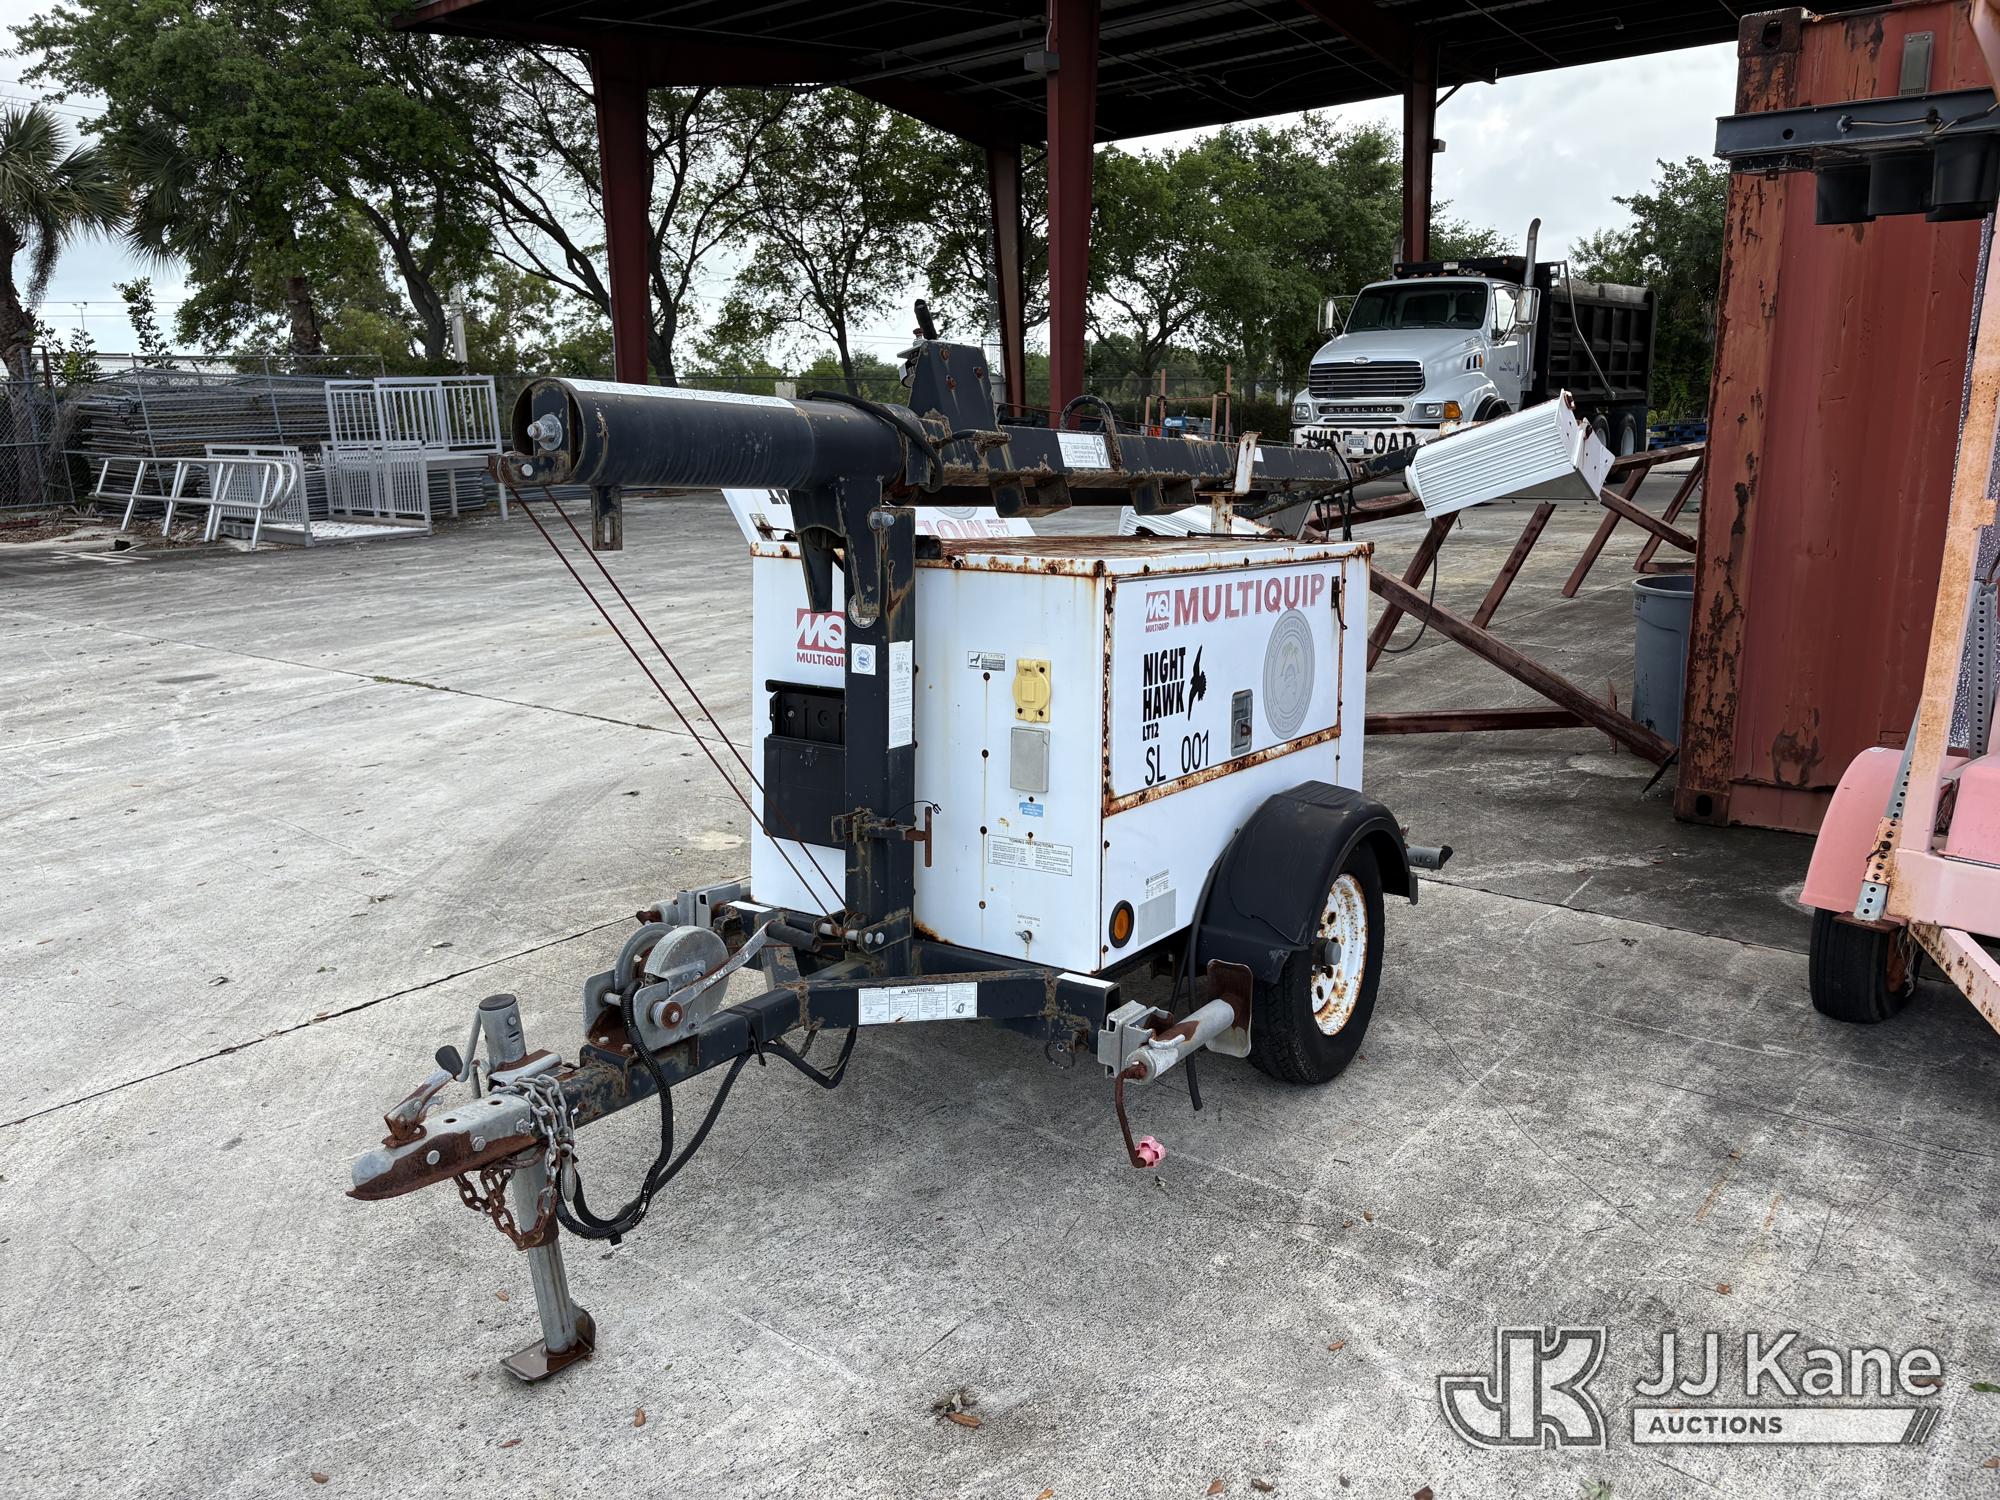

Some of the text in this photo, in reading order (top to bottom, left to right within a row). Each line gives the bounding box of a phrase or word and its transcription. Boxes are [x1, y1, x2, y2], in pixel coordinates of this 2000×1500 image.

[1174, 573, 1325, 628] MULTIQUIP
[1145, 622, 1169, 633] MULTIQUIP
[796, 652, 845, 667] MULTIQUI
[1143, 646, 1186, 688] NIGHT
[1142, 679, 1185, 723] HAWK
[1142, 722, 1159, 741] LT12
[1145, 729, 1209, 787] SL 001
